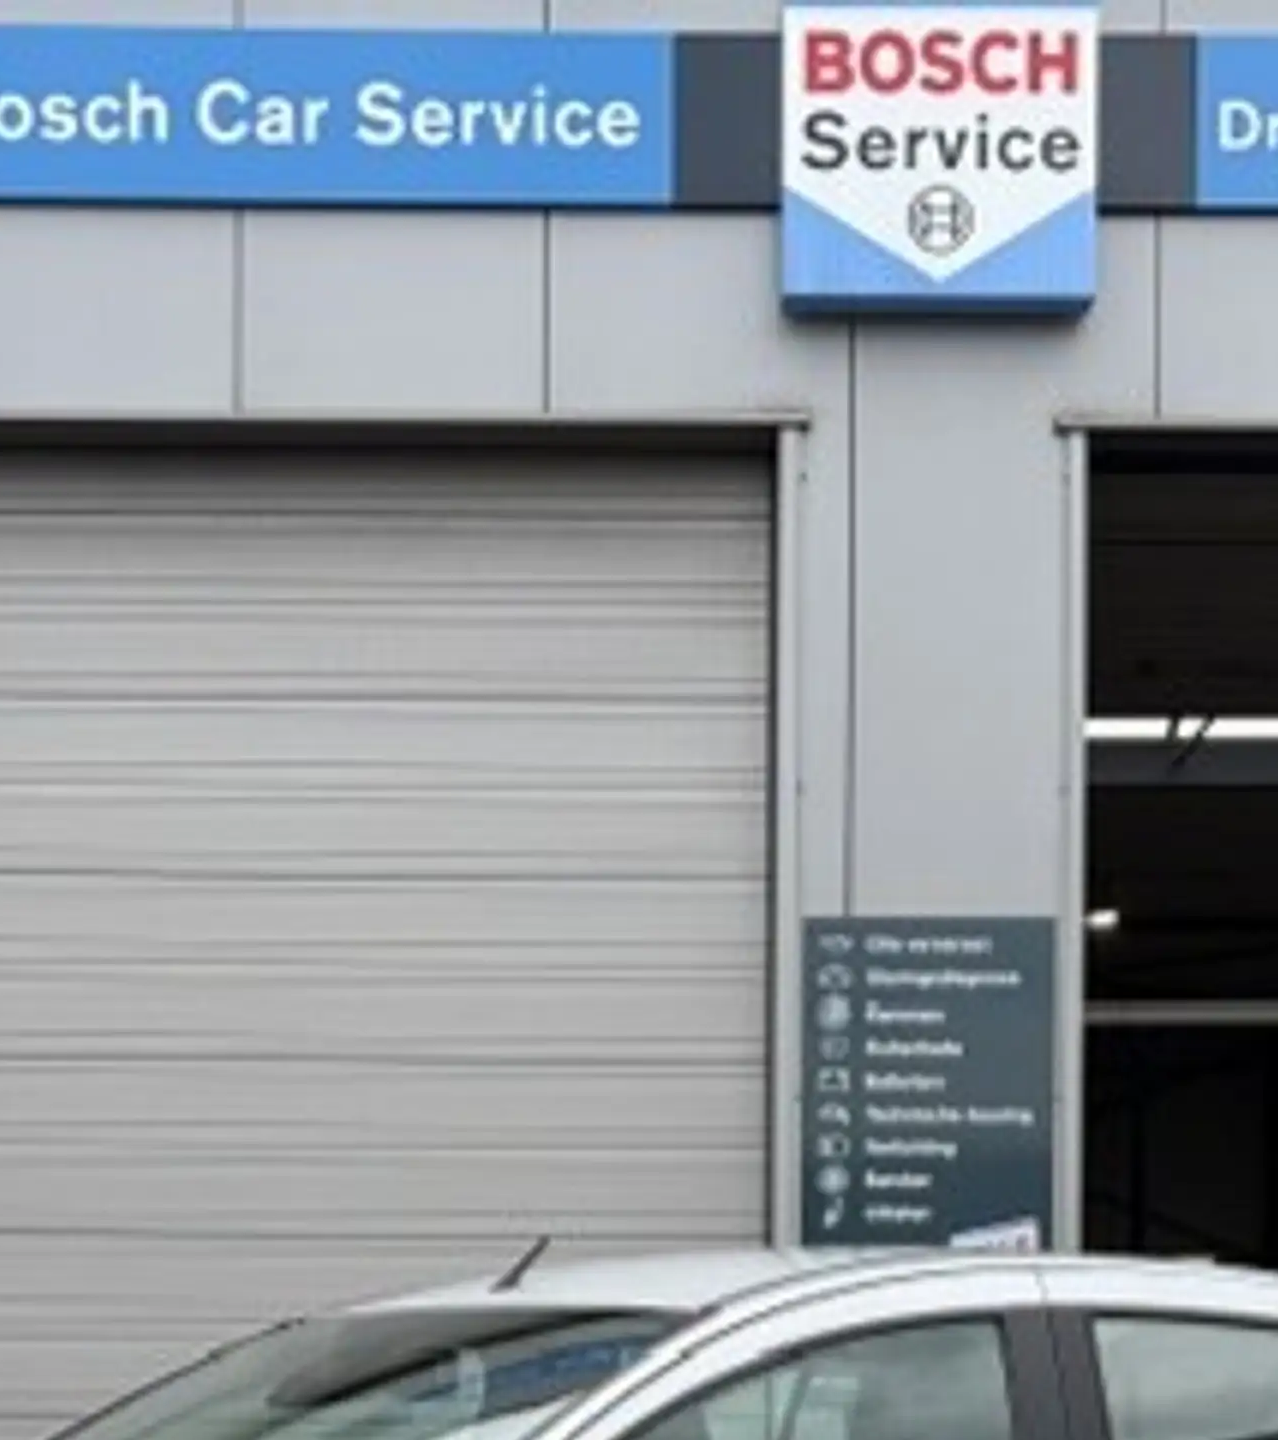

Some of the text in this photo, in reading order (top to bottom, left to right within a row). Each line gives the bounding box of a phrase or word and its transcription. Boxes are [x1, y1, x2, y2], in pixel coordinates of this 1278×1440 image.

[802, 29, 1081, 95] BOSCH
[197, 80, 329, 145] Car
[356, 82, 640, 148] Service
[801, 111, 1081, 172] Service
